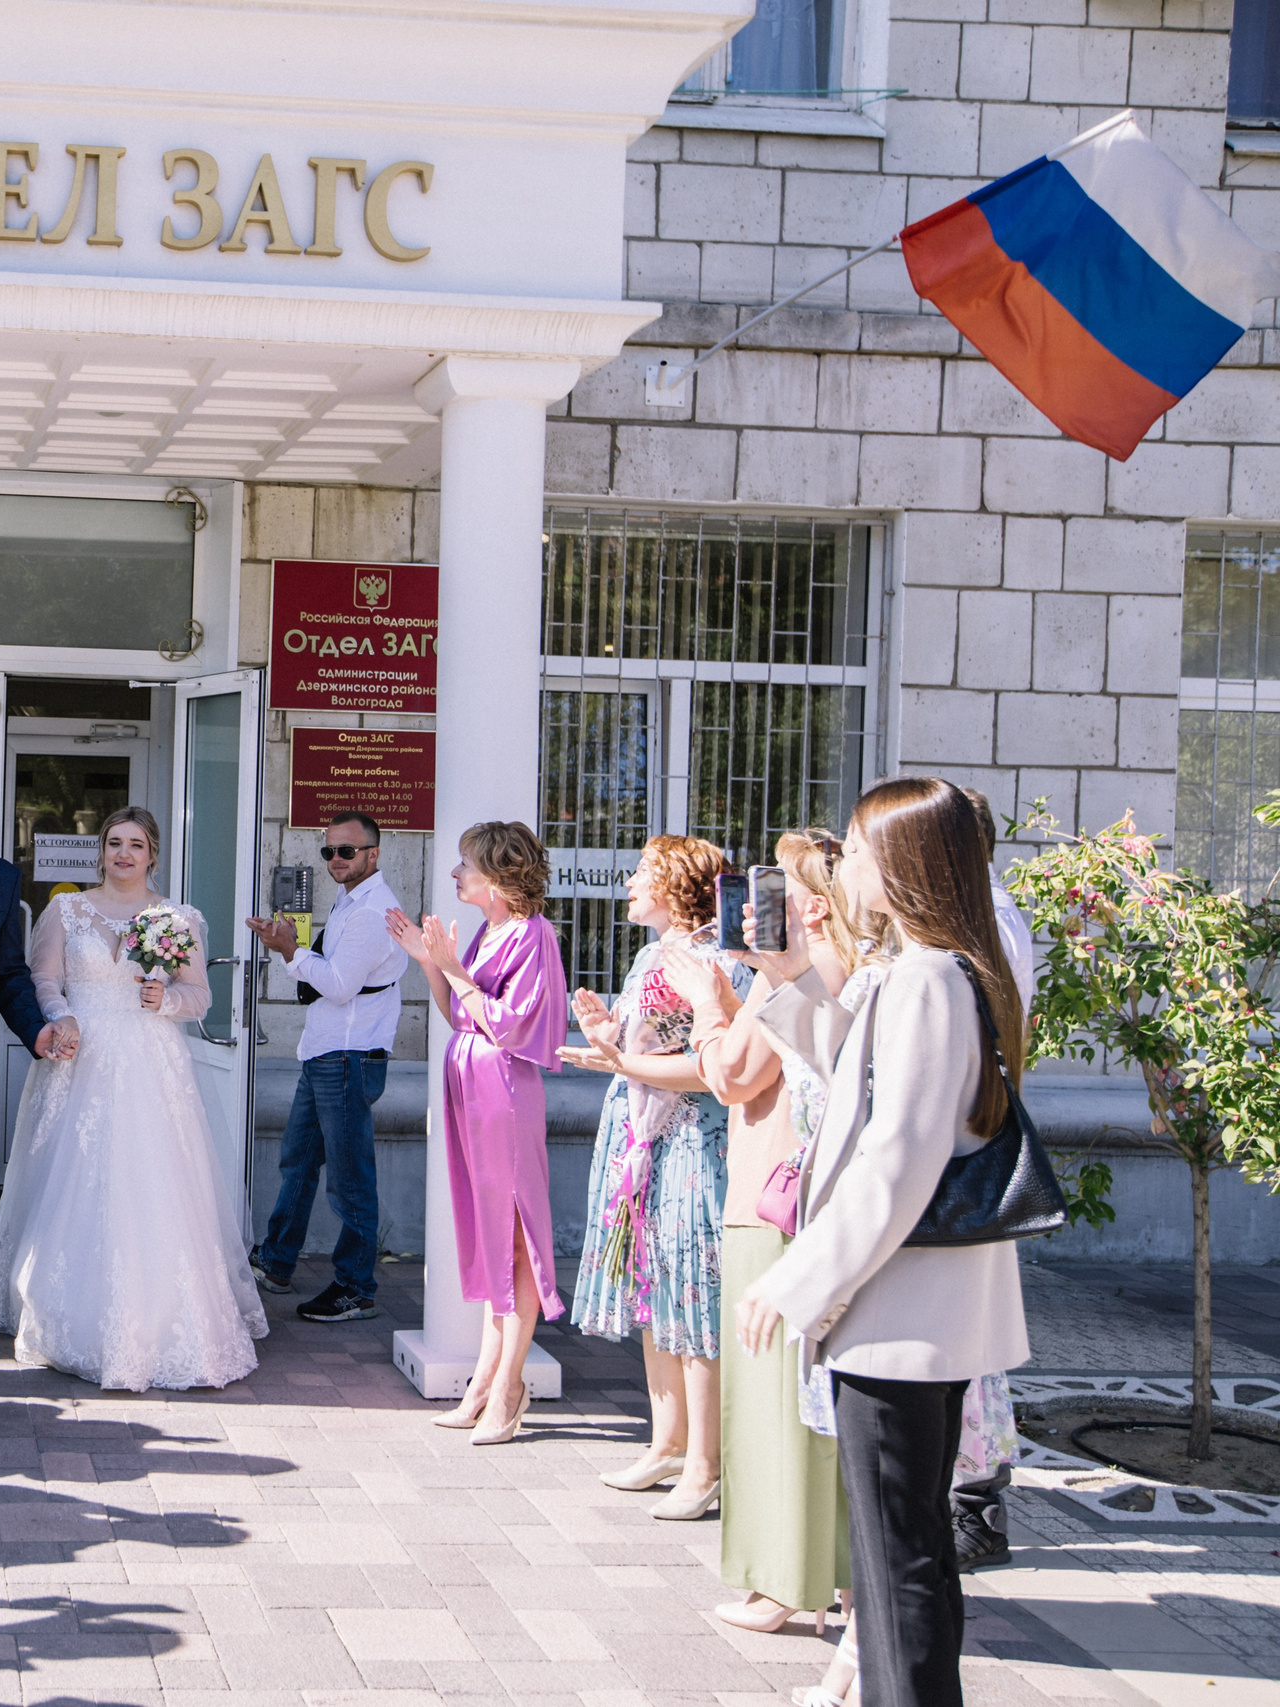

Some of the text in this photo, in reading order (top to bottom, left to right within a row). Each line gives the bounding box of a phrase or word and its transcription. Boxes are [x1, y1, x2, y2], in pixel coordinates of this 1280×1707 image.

[160, 148, 436, 263] ЗАГС
[300, 611, 370, 625] Российская
[283, 629, 375, 658] Отдел
[318, 668, 418, 681] администрации
[296, 680, 389, 693] Дзержинского
[331, 695, 403, 709] Волгограда
[338, 733, 395, 743] Отдел ЗАГС
[330, 766, 400, 777] График работы:
[357, 792, 378, 800] 13.00
[319, 803, 350, 812] суббота
[36, 839, 99, 847] ОСТОРОЖНО!
